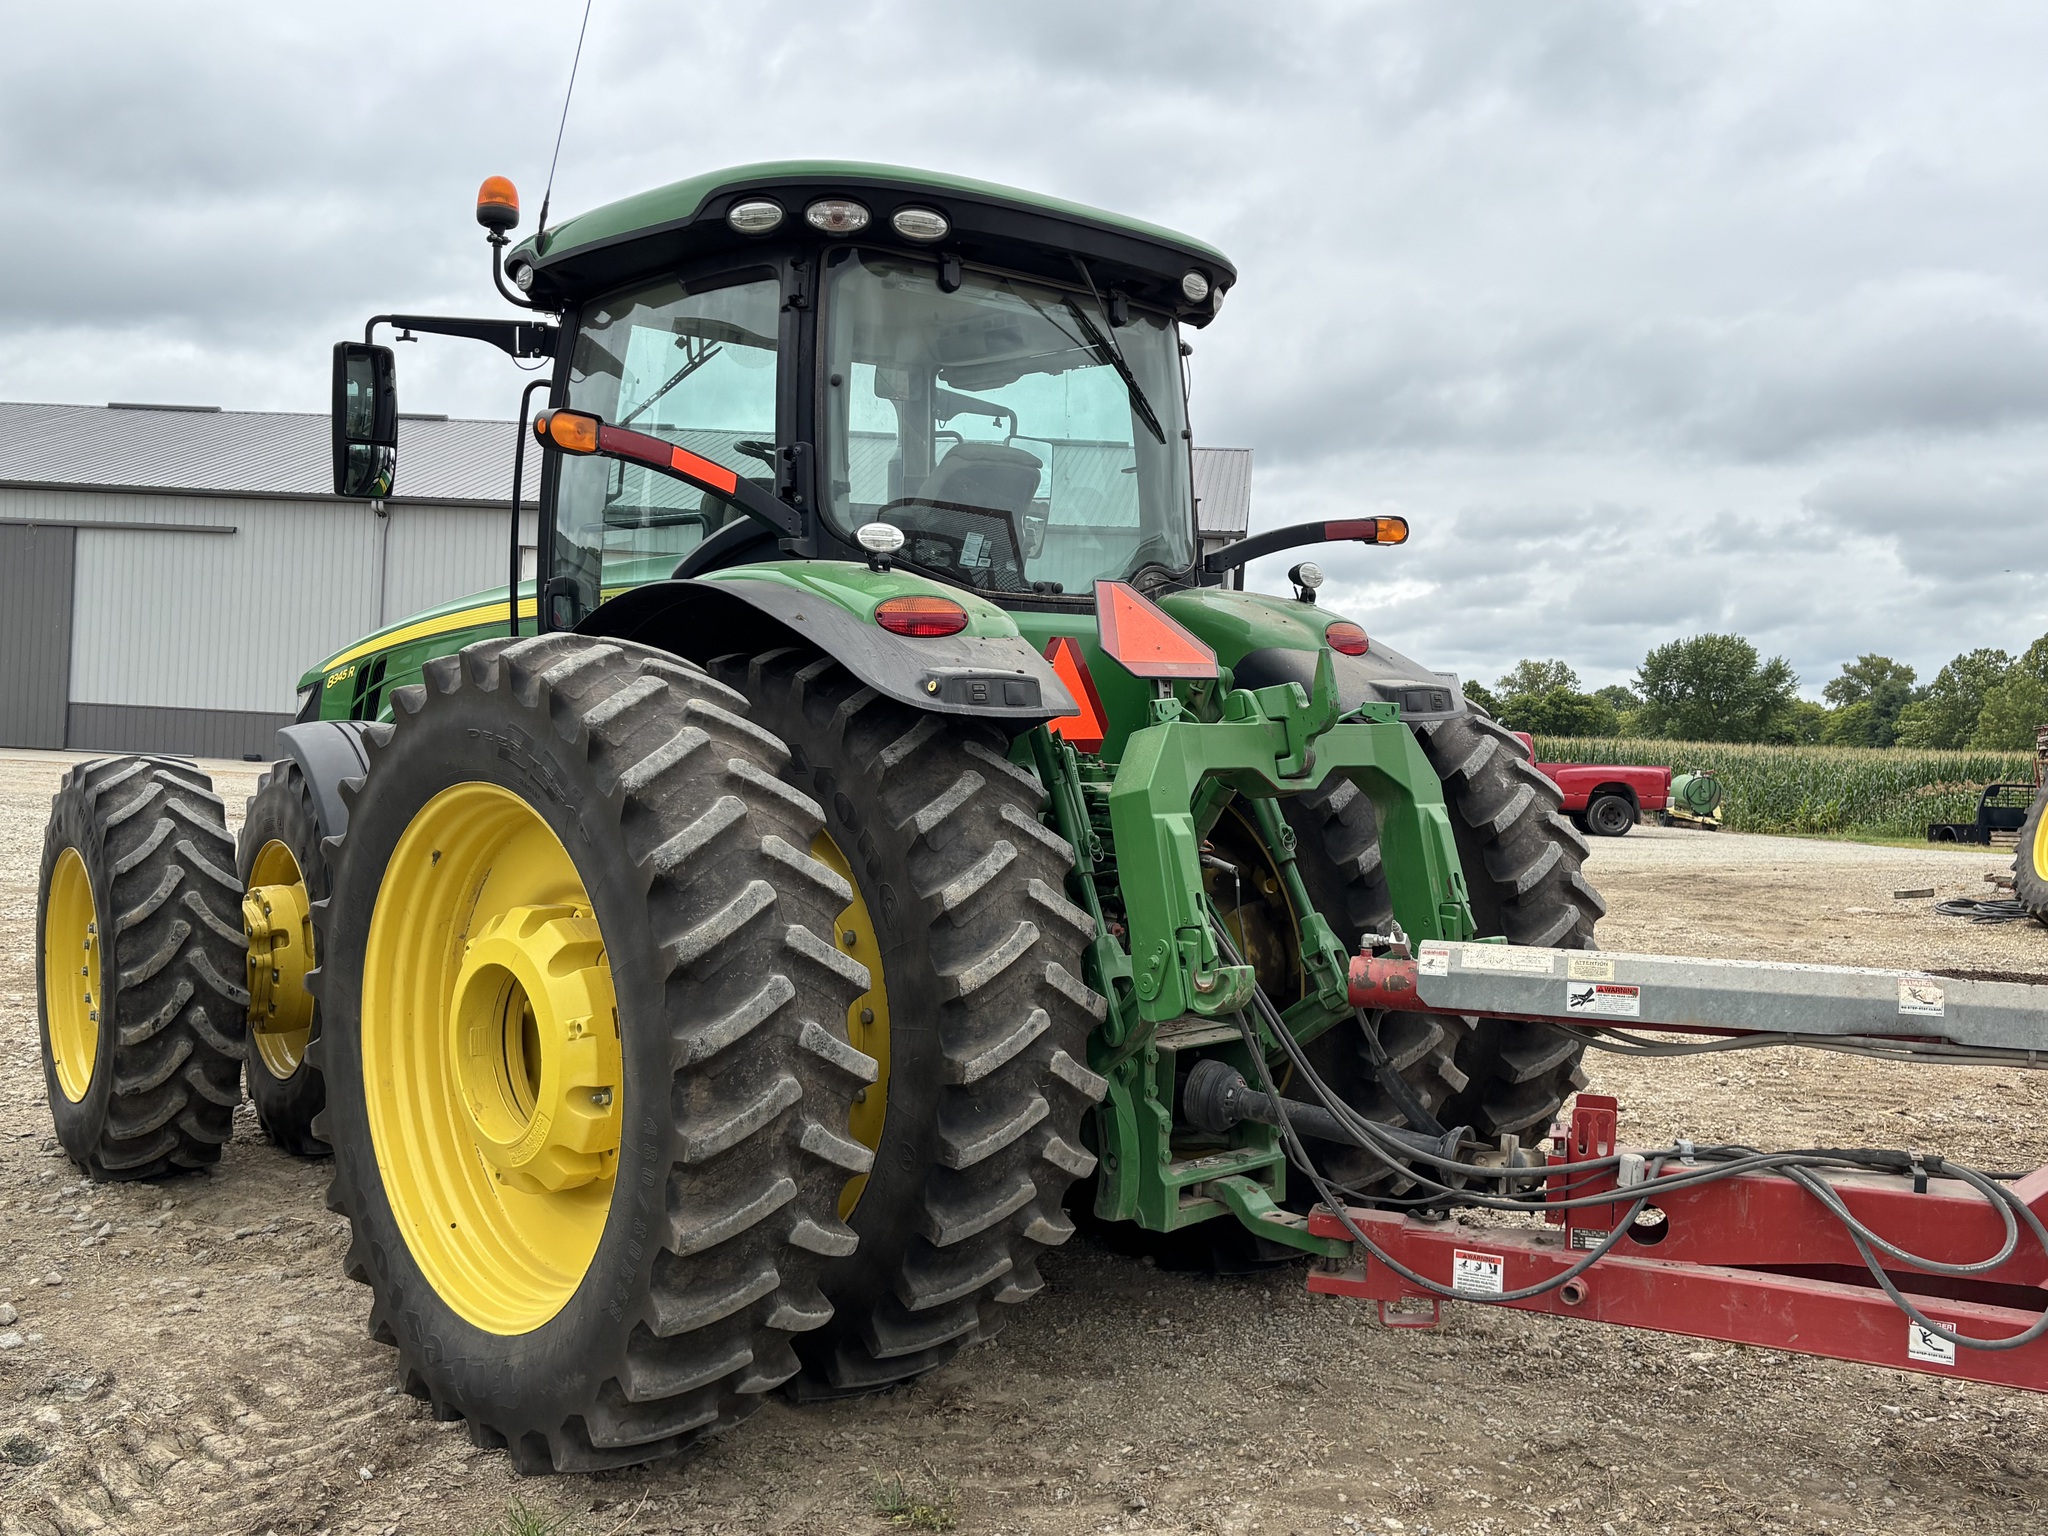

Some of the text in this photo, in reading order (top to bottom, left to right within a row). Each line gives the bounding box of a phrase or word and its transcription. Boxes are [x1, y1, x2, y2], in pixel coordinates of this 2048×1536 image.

[327, 665, 356, 689] 8345 R
[467, 728, 522, 757] DEEP
[1467, 1253, 1495, 1263] WARNING
